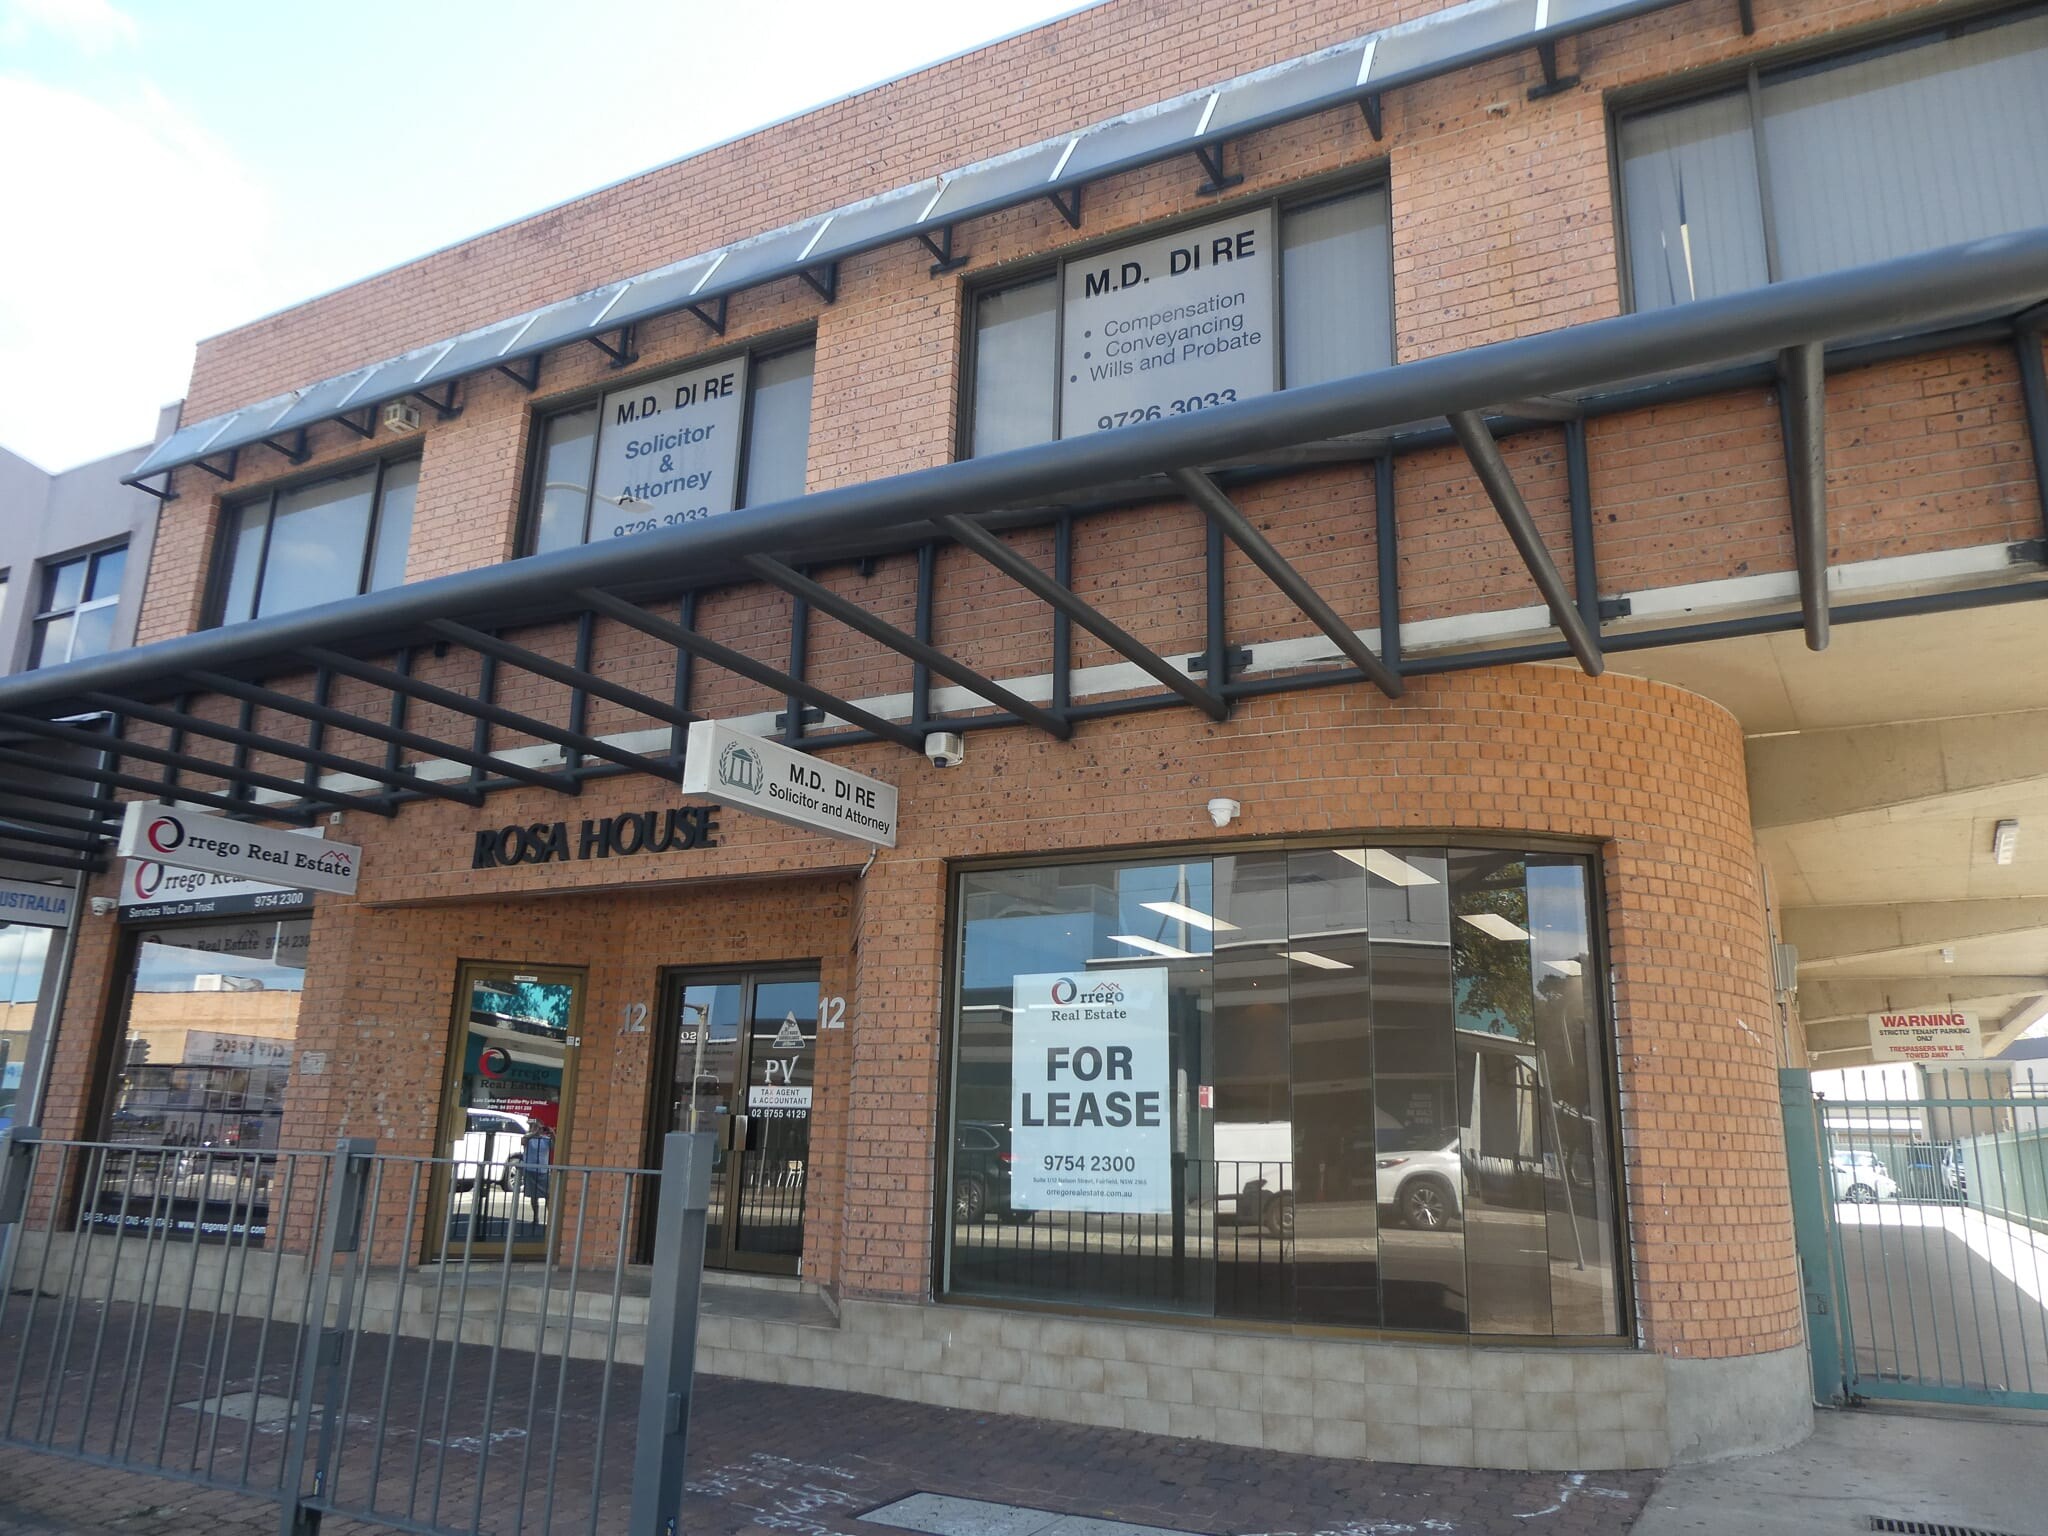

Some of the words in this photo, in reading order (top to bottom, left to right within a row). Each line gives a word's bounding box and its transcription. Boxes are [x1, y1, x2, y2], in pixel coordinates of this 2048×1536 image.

[1086, 263, 1149, 299] M.D.
[1171, 245, 1200, 277] DI
[1213, 230, 1255, 266] RE
[1104, 292, 1245, 337] Compensation
[1106, 314, 1243, 357] Conveyancing
[1090, 361, 1133, 382] Wills
[1140, 349, 1175, 371] and
[1184, 332, 1262, 361] Probate
[617, 396, 661, 425] M.D.
[675, 384, 697, 409] DI
[704, 373, 734, 401] RE
[1098, 406, 1161, 430] 9726
[1170, 389, 1236, 416] 3033
[625, 425, 715, 459] Solicitor
[660, 454, 674, 473] &
[619, 471, 712, 505] Attorney
[614, 519, 657, 537] 9726
[790, 763, 825, 792] M.D.
[835, 779, 850, 801] DI
[856, 787, 876, 809] RE
[769, 783, 819, 810] Solicitor
[822, 803, 843, 818] and
[845, 808, 890, 835] Attorney
[148, 816, 240, 857] Orrego
[248, 844, 289, 865] Real
[295, 853, 351, 877] Estate
[472, 822, 570, 869] ROSA
[578, 805, 721, 860] HOUSE
[211, 873, 249, 885] Rea
[129, 908, 161, 918] Services
[163, 905, 176, 915] You
[178, 904, 193, 914] Can
[195, 902, 215, 913] Trust
[255, 896, 278, 908] 9754
[280, 893, 304, 905] 2300
[1052, 977, 1124, 1005] Orrego
[623, 1002, 647, 1032] 12
[819, 996, 846, 1029] 12
[1052, 1010, 1080, 1021] Real
[1085, 1009, 1127, 1020] Estate
[1881, 1014, 1965, 1028] WARNING
[765, 1055, 800, 1084] PV
[1047, 1045, 1133, 1082] FOR
[760, 1097, 808, 1105] ACCOUNTANT
[776, 1089, 801, 1097] AGENT
[752, 1109, 762, 1118] 02
[764, 1109, 784, 1118] 9755
[786, 1110, 807, 1119] 4129
[1022, 1091, 1160, 1127] LEASE
[1044, 1155, 1085, 1171] 9754
[1091, 1156, 1136, 1172] 2300
[1047, 1189, 1133, 1198] orregorealestate.com.au
